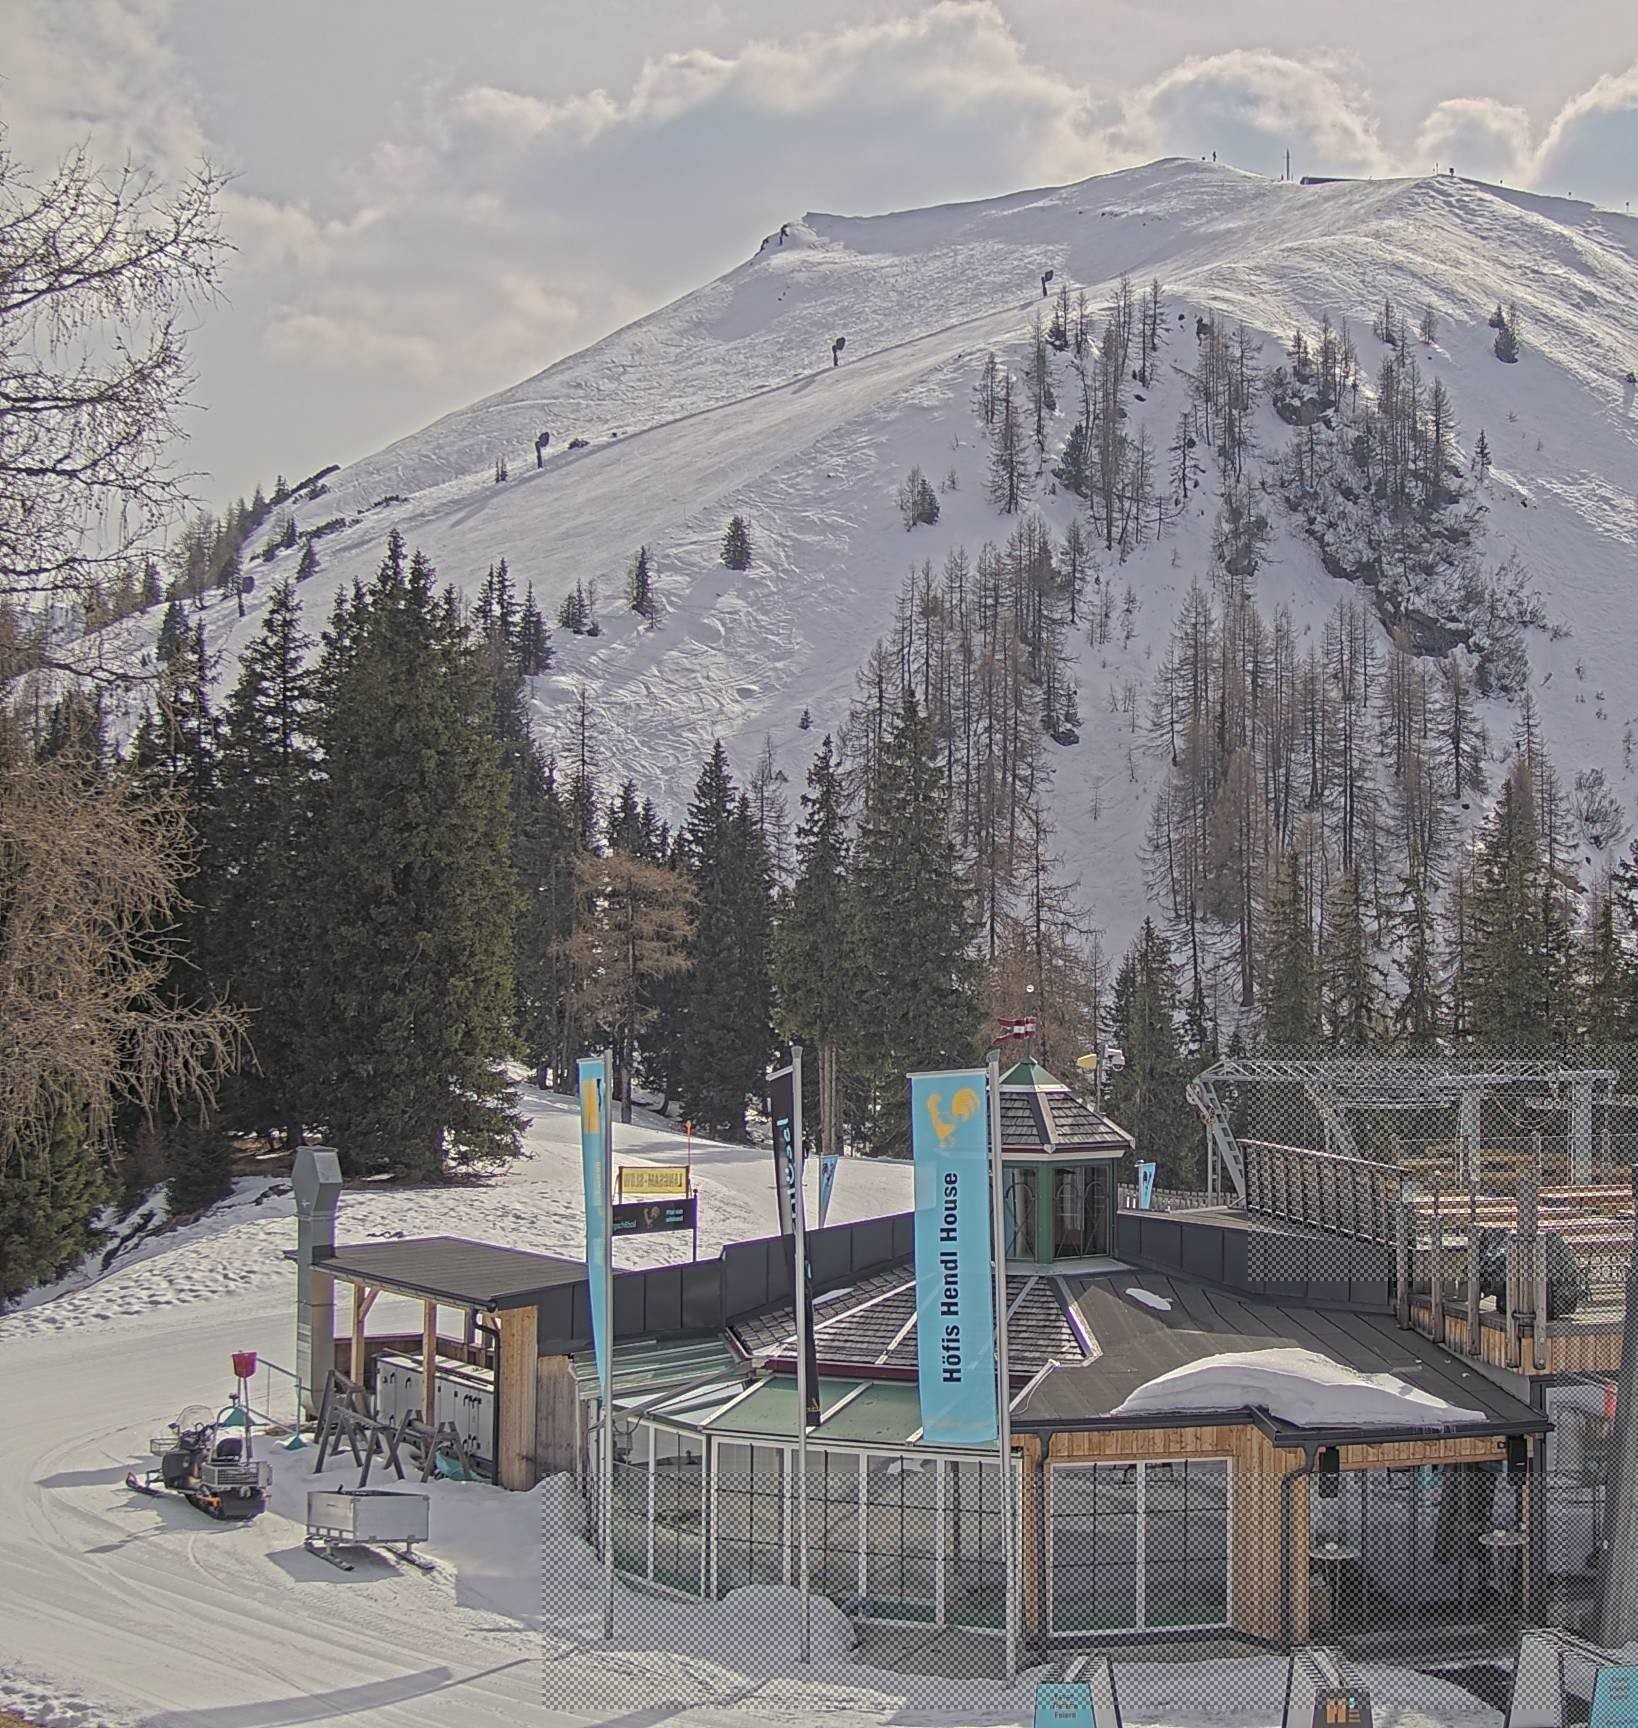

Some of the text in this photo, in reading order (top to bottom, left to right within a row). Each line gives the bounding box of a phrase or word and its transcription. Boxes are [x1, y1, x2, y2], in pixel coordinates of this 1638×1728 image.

[939, 1172, 962, 1383] Höfis Hendl House
